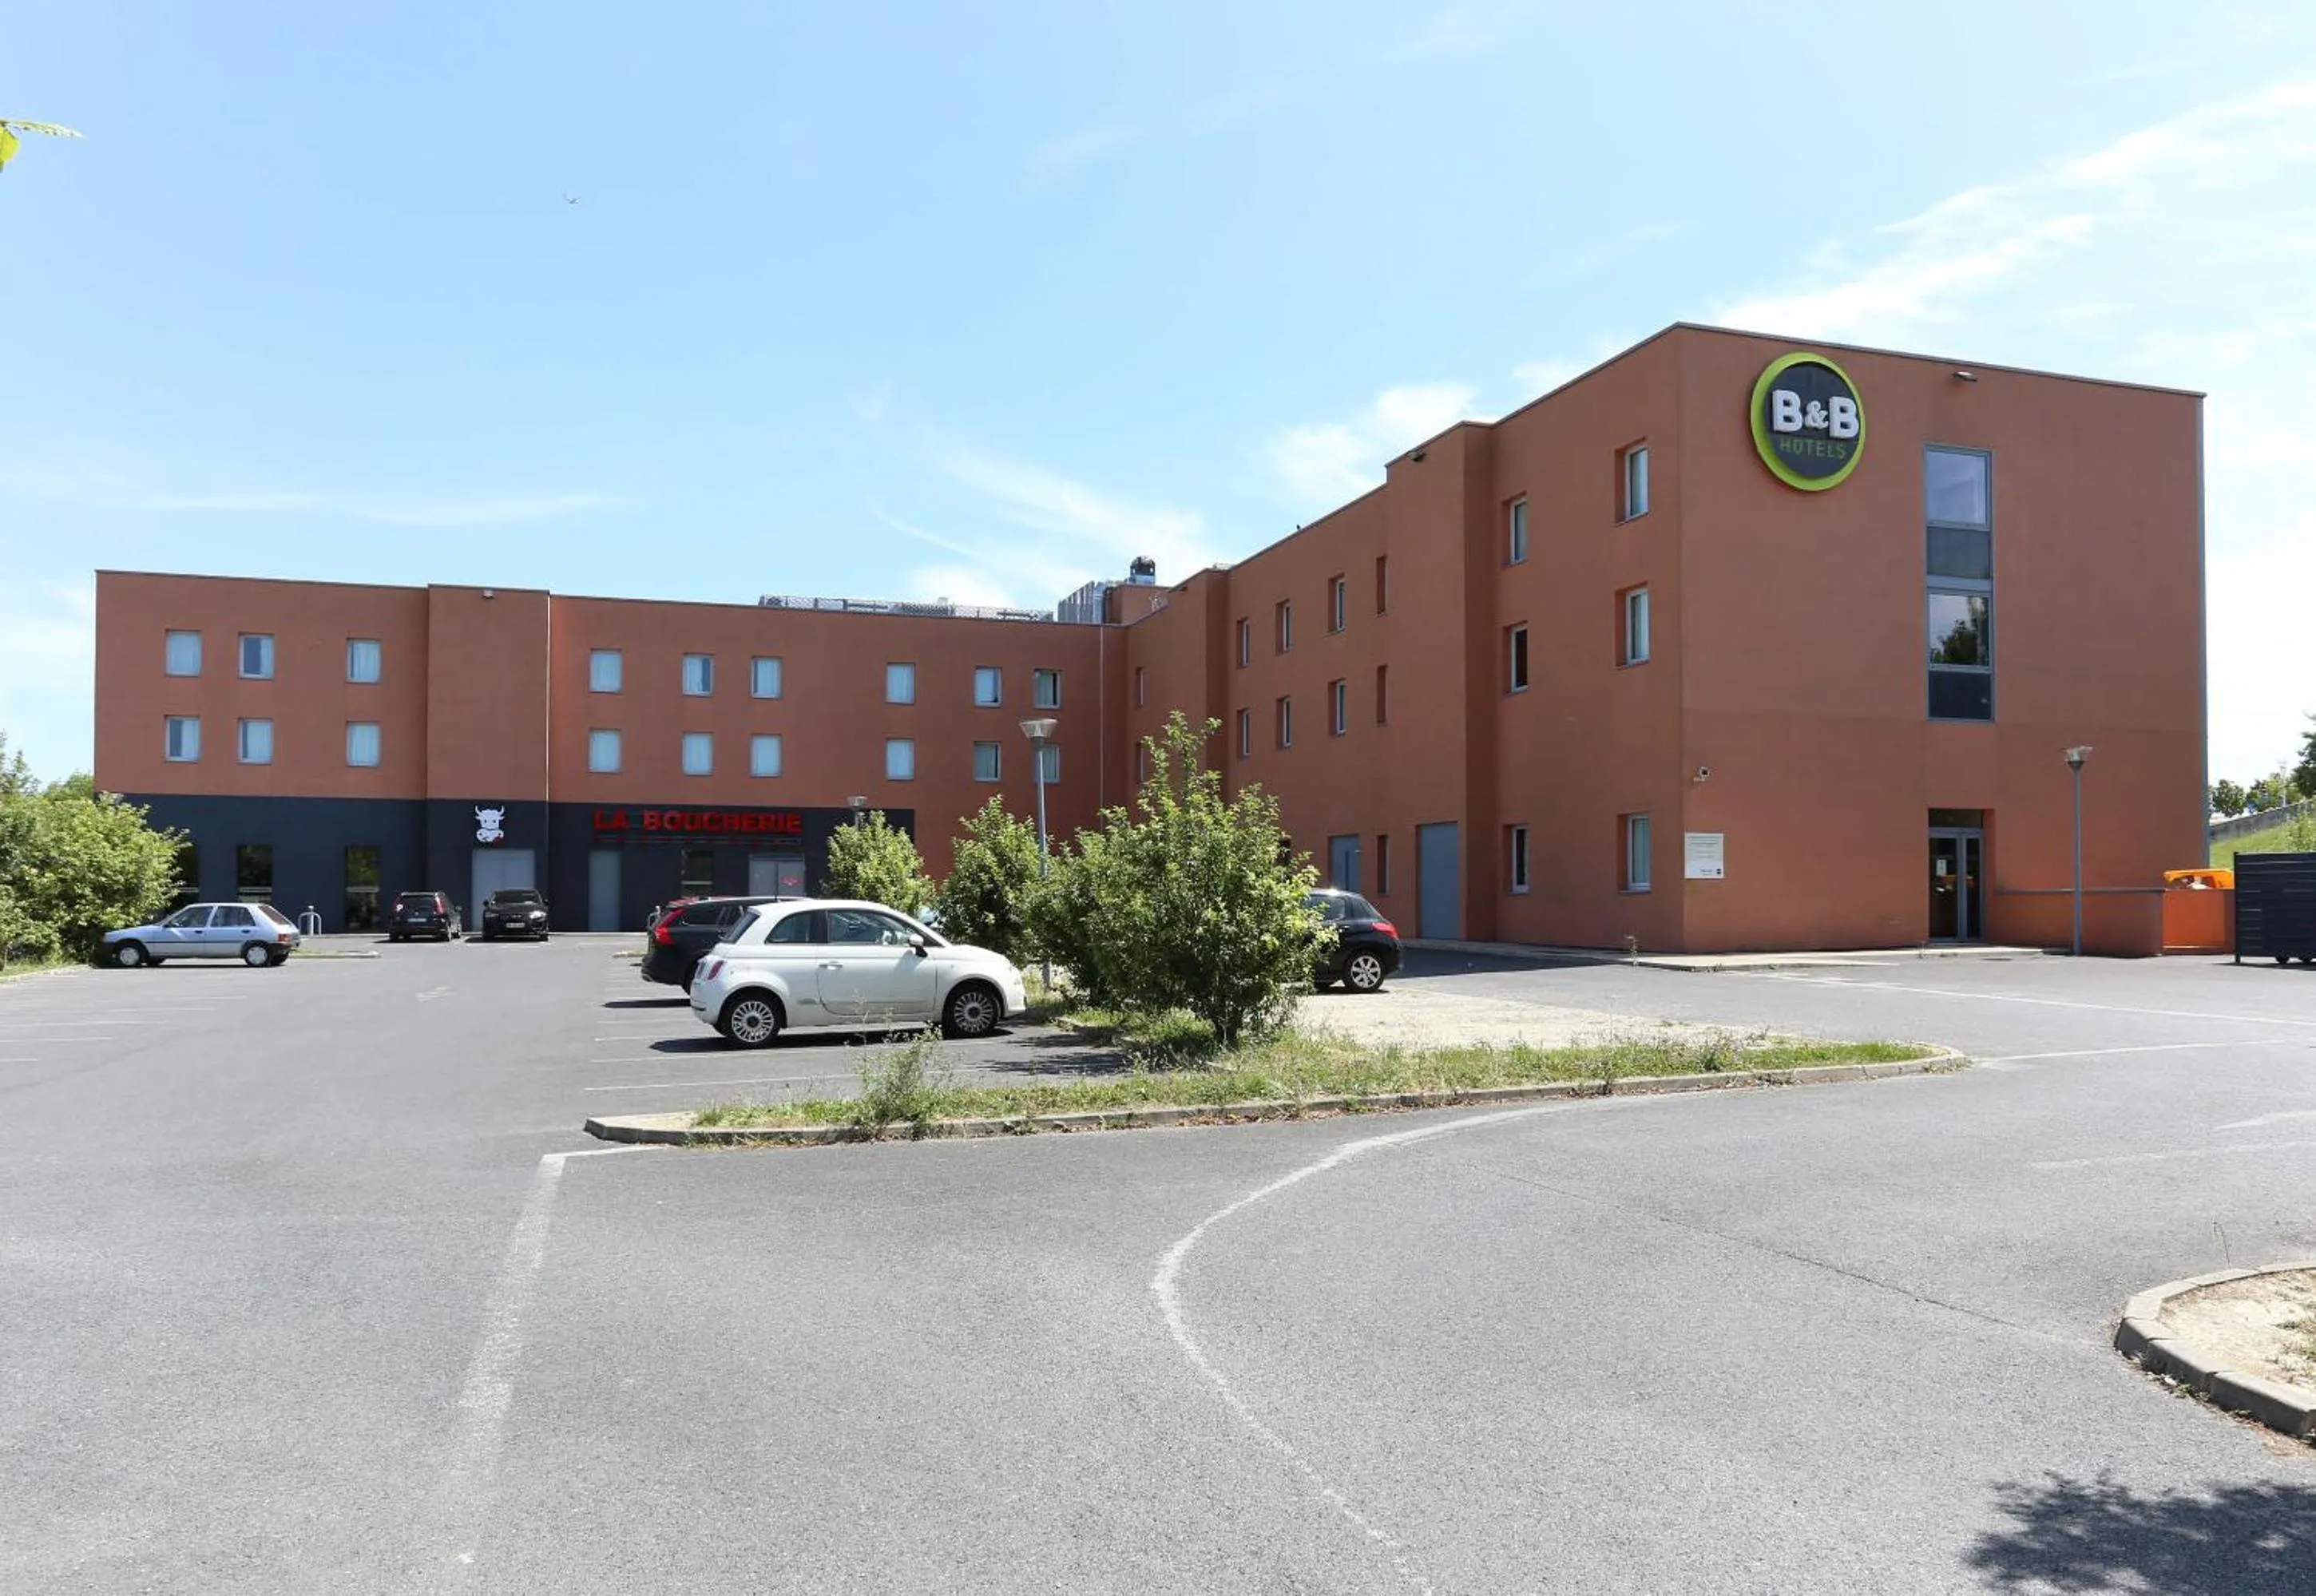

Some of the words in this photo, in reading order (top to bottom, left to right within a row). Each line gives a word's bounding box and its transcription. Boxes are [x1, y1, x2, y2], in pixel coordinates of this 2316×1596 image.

[1772, 390, 1859, 438] B&B
[1780, 438, 1846, 457] HOTELS
[593, 810, 629, 830] LA
[643, 810, 803, 834] BOUCHERIE
